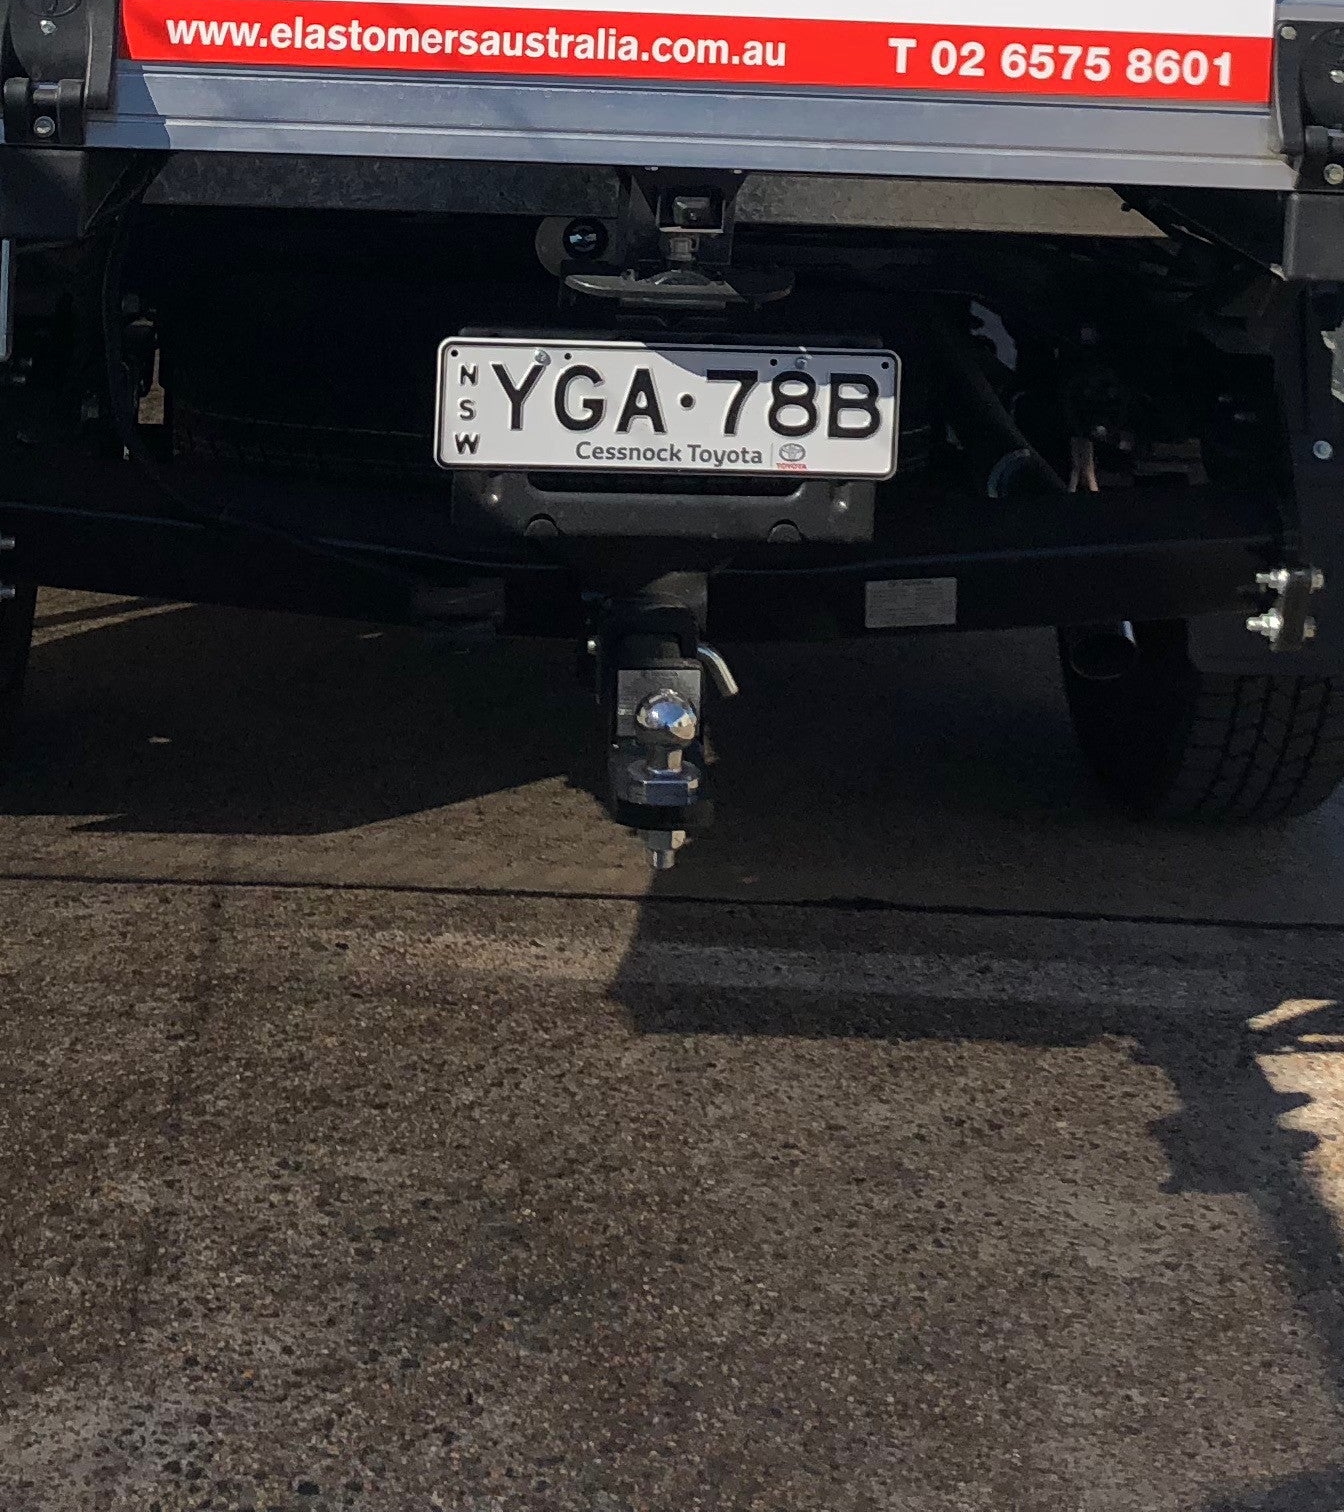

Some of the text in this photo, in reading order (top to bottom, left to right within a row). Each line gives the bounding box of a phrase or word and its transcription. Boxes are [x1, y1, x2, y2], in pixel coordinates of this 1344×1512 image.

[165, 18, 787, 68] www.elastomersaustralia.com.au
[888, 38, 1233, 87] T 02 6575 8601
[576, 441, 764, 468] Cessnock Toyota
